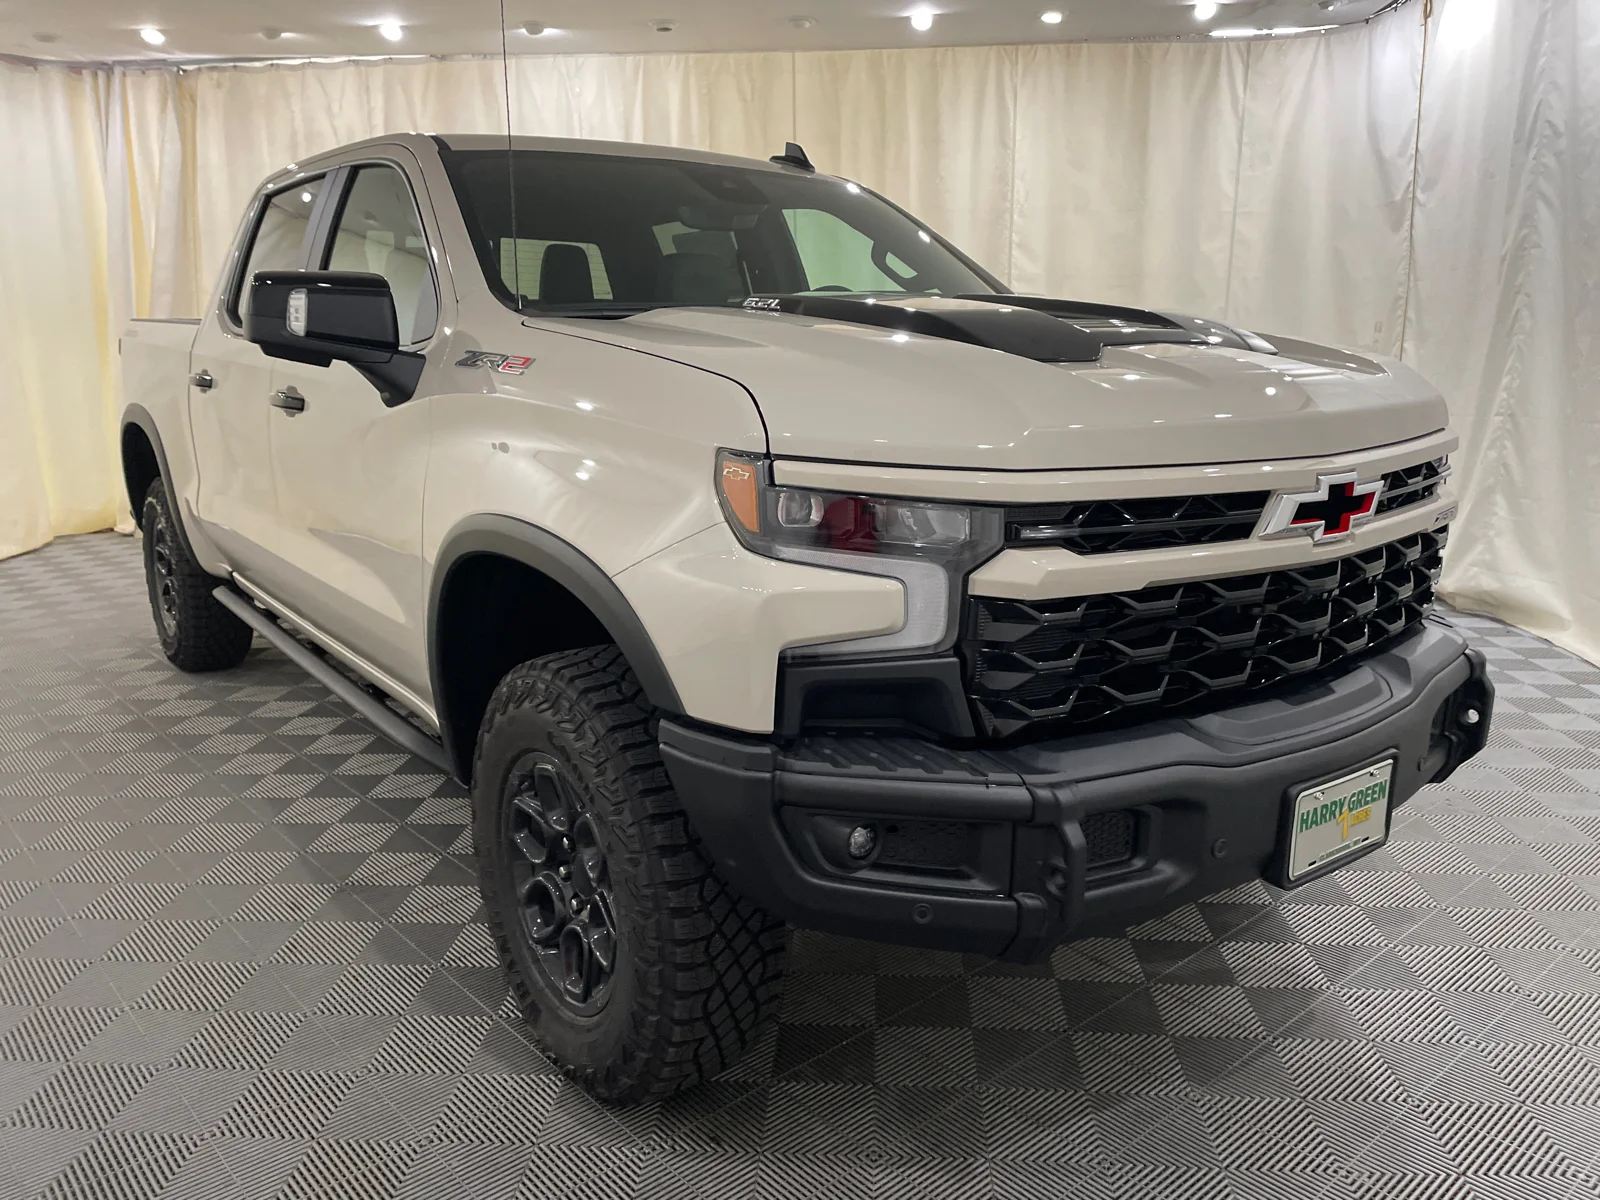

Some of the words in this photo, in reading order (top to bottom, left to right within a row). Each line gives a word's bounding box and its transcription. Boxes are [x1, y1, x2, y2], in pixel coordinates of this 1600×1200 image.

[455, 350, 536, 375] ZR2
[1300, 796, 1347, 833] HARRY
[1348, 779, 1388, 812] GREEN
[1337, 807, 1350, 841] 1
